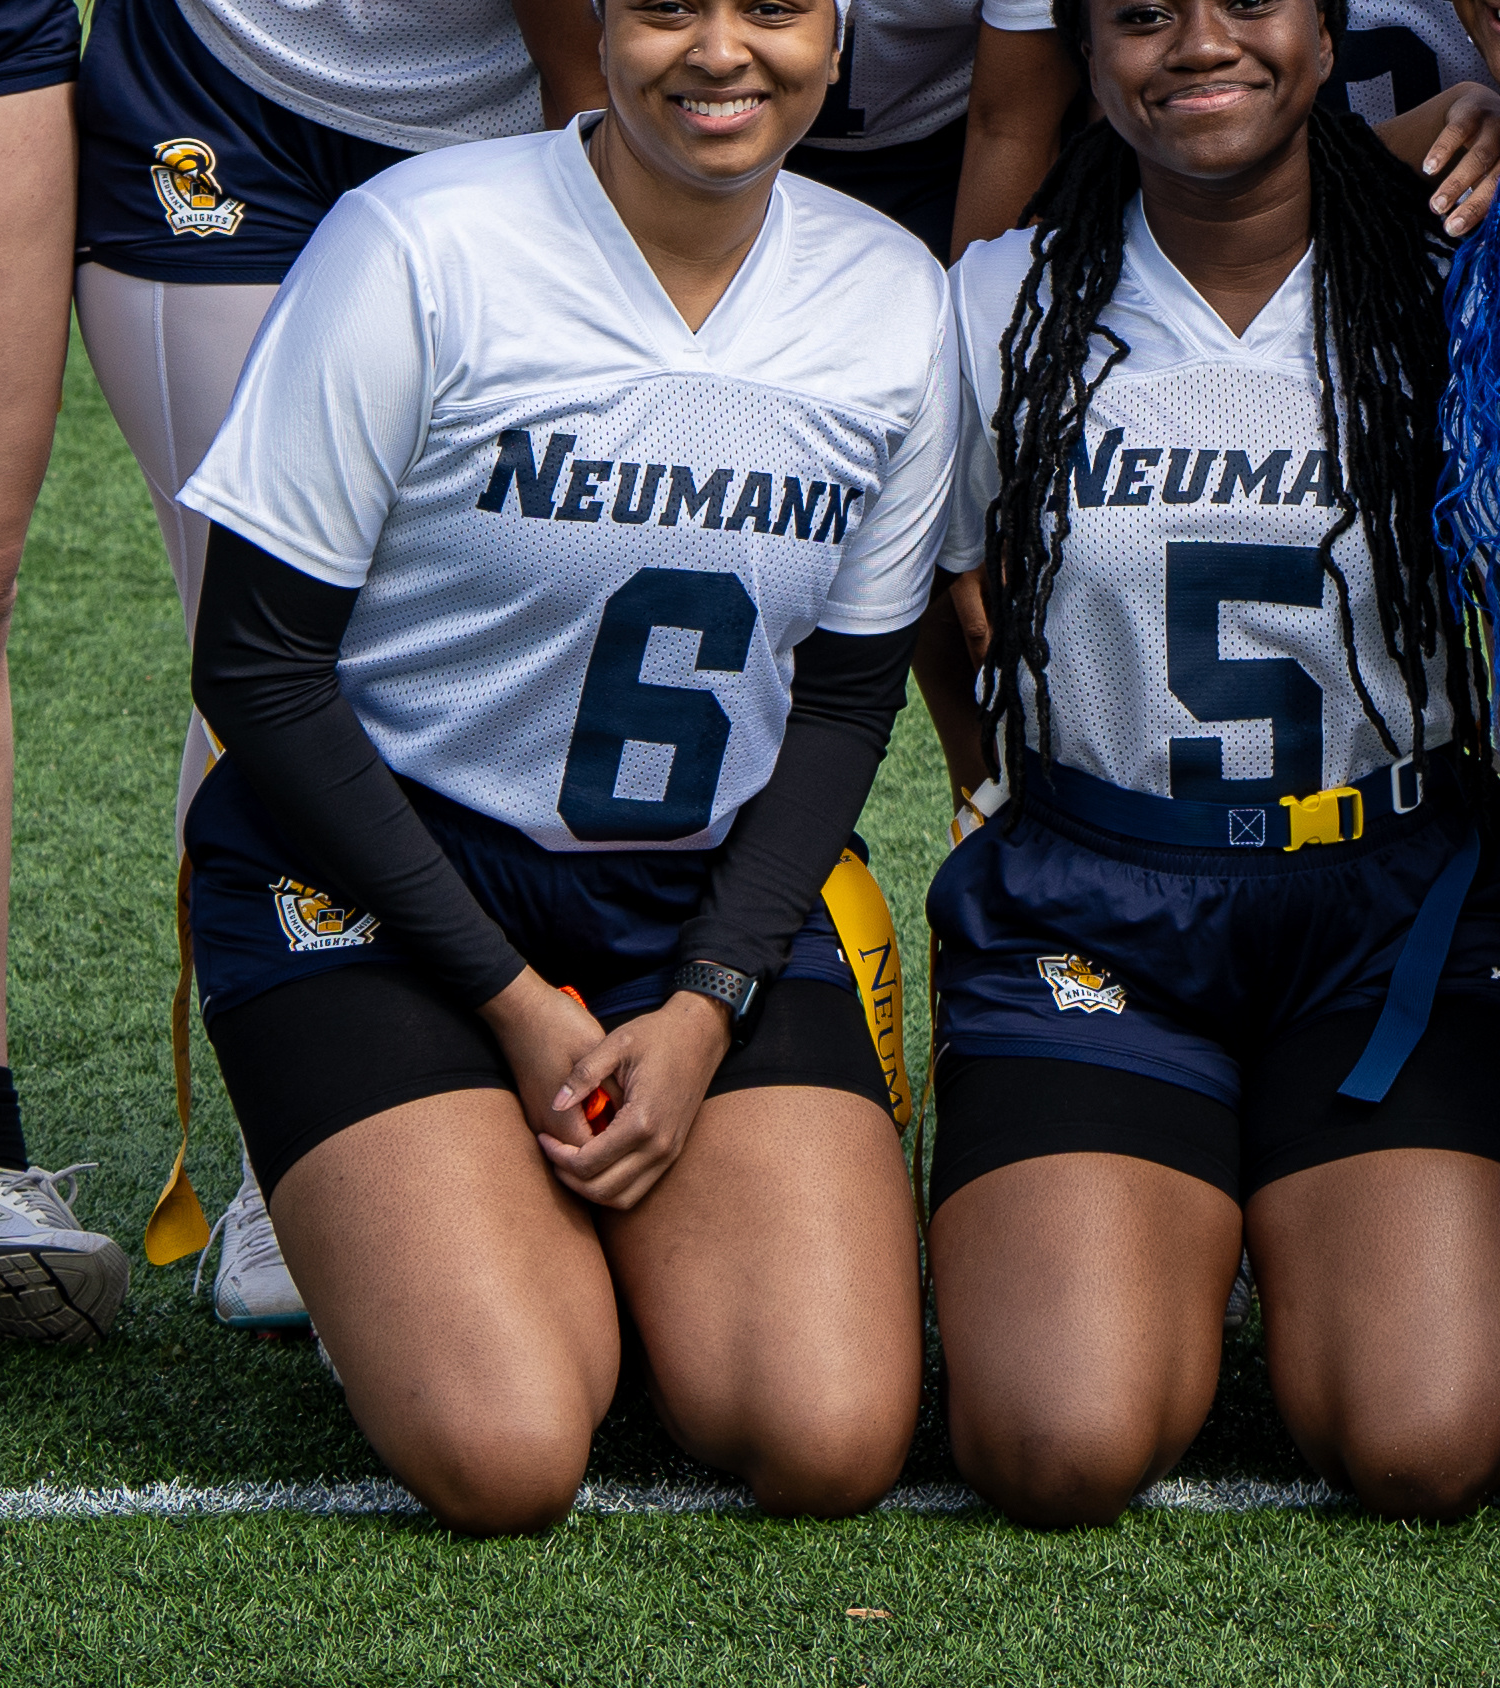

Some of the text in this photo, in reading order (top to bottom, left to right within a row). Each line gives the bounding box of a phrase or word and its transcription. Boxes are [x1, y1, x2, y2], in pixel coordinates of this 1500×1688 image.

[177, 213, 229, 225] KNIGHTS
[476, 429, 863, 544] NEUMANN
[557, 567, 759, 842] 6
[1165, 541, 1324, 806] 5
[301, 937, 358, 951] KNIGHTS
